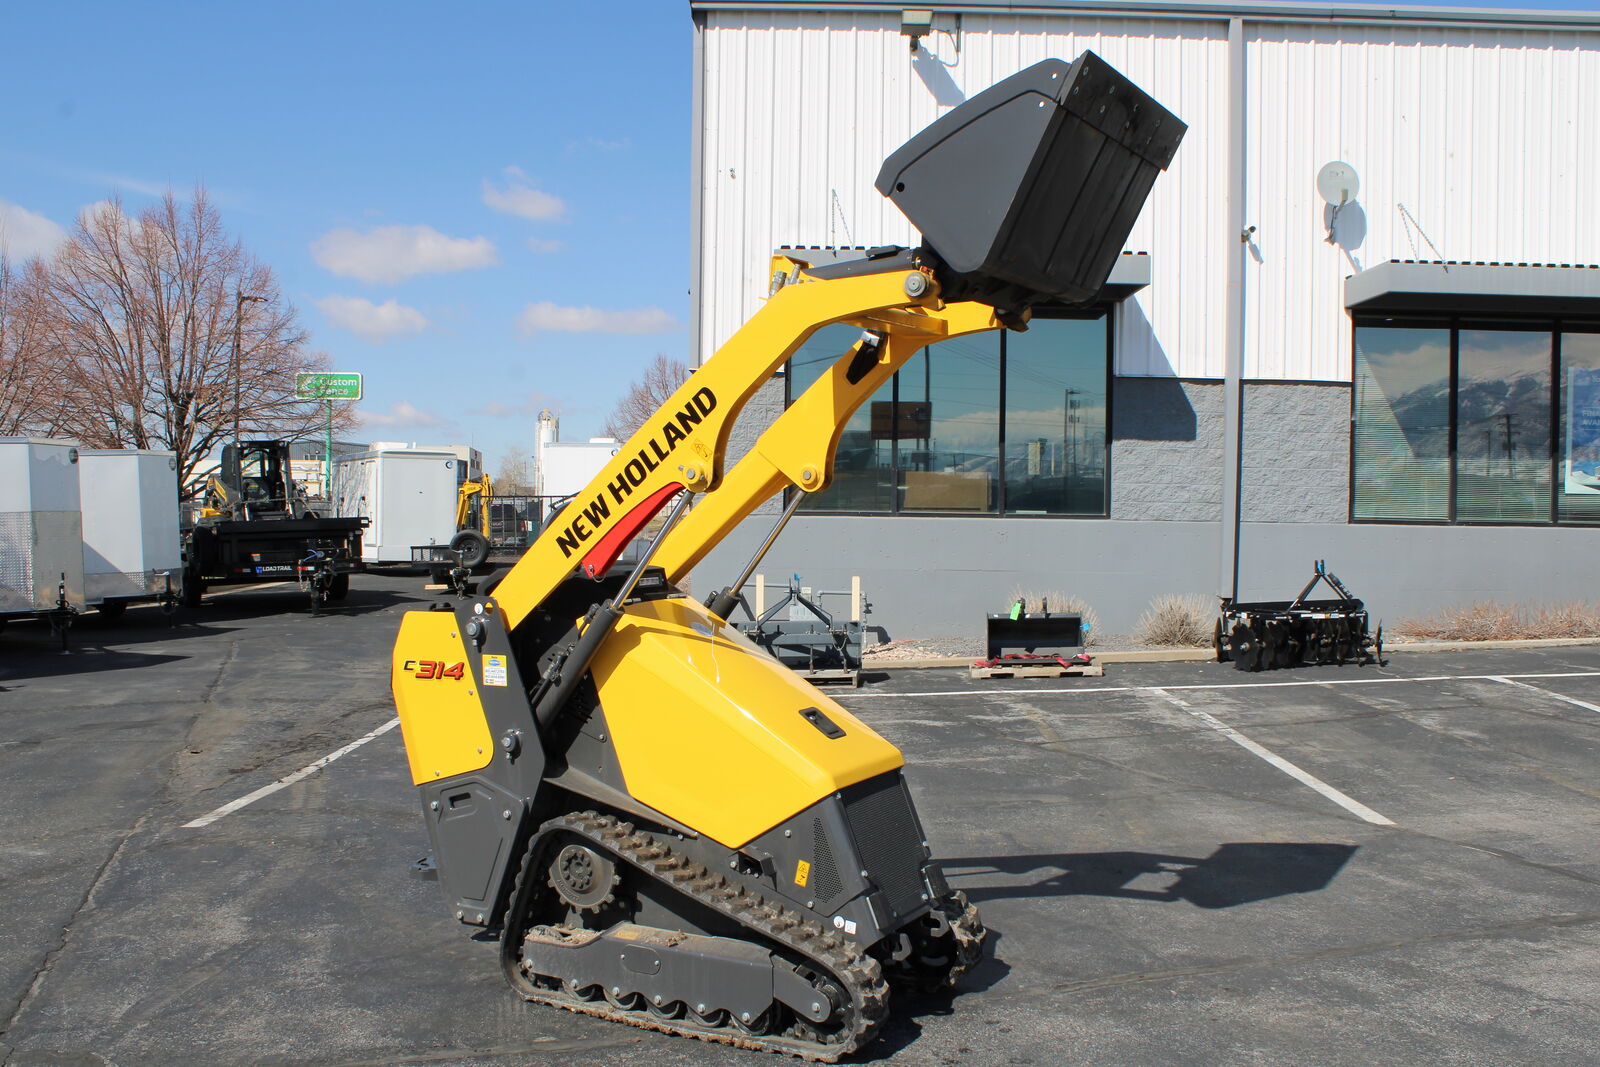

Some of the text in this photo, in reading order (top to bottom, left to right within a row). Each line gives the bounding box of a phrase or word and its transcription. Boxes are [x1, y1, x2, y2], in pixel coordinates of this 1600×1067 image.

[320, 377, 357, 386] Custom
[555, 386, 718, 559] NEW HOLLAND
